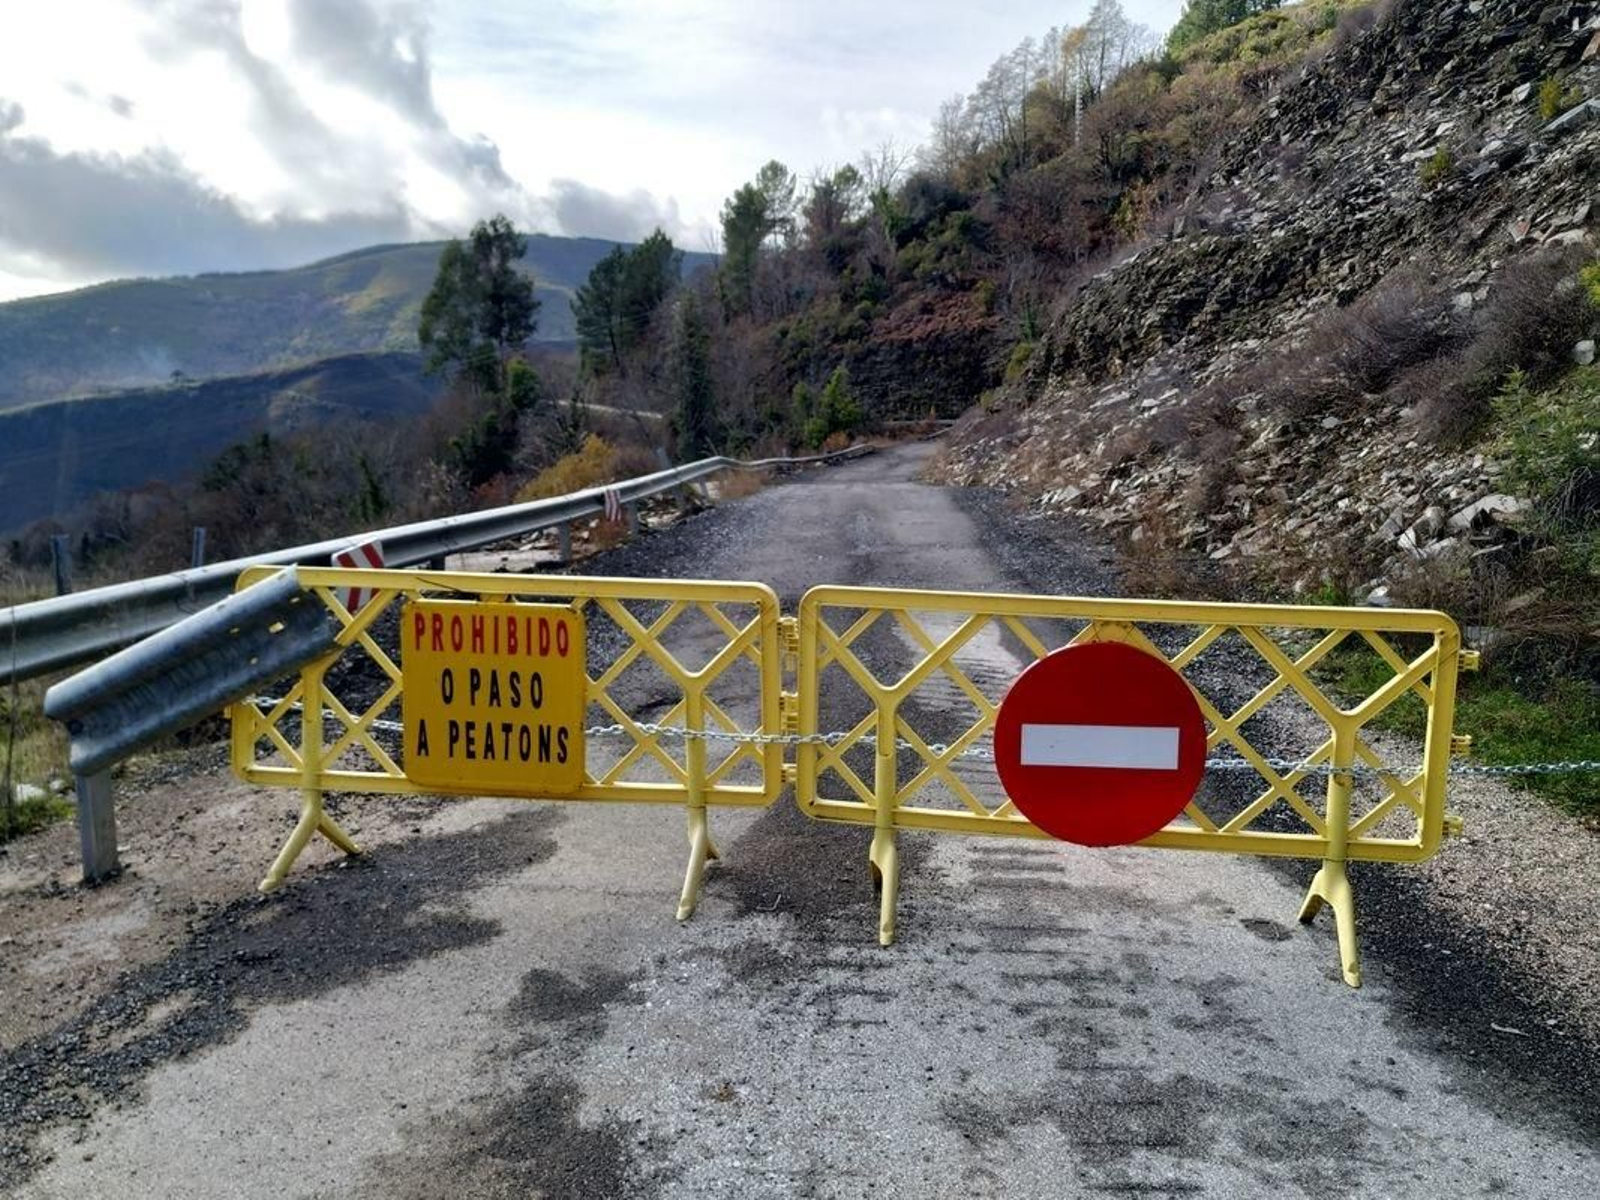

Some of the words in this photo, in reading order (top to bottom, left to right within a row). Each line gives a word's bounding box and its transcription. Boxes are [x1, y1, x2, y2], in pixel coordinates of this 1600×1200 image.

[414, 612, 570, 657] PROHIBIDO
[441, 668, 454, 704] O
[470, 668, 543, 709] PASO
[417, 719, 429, 756] A
[449, 720, 569, 764] PEATONS
